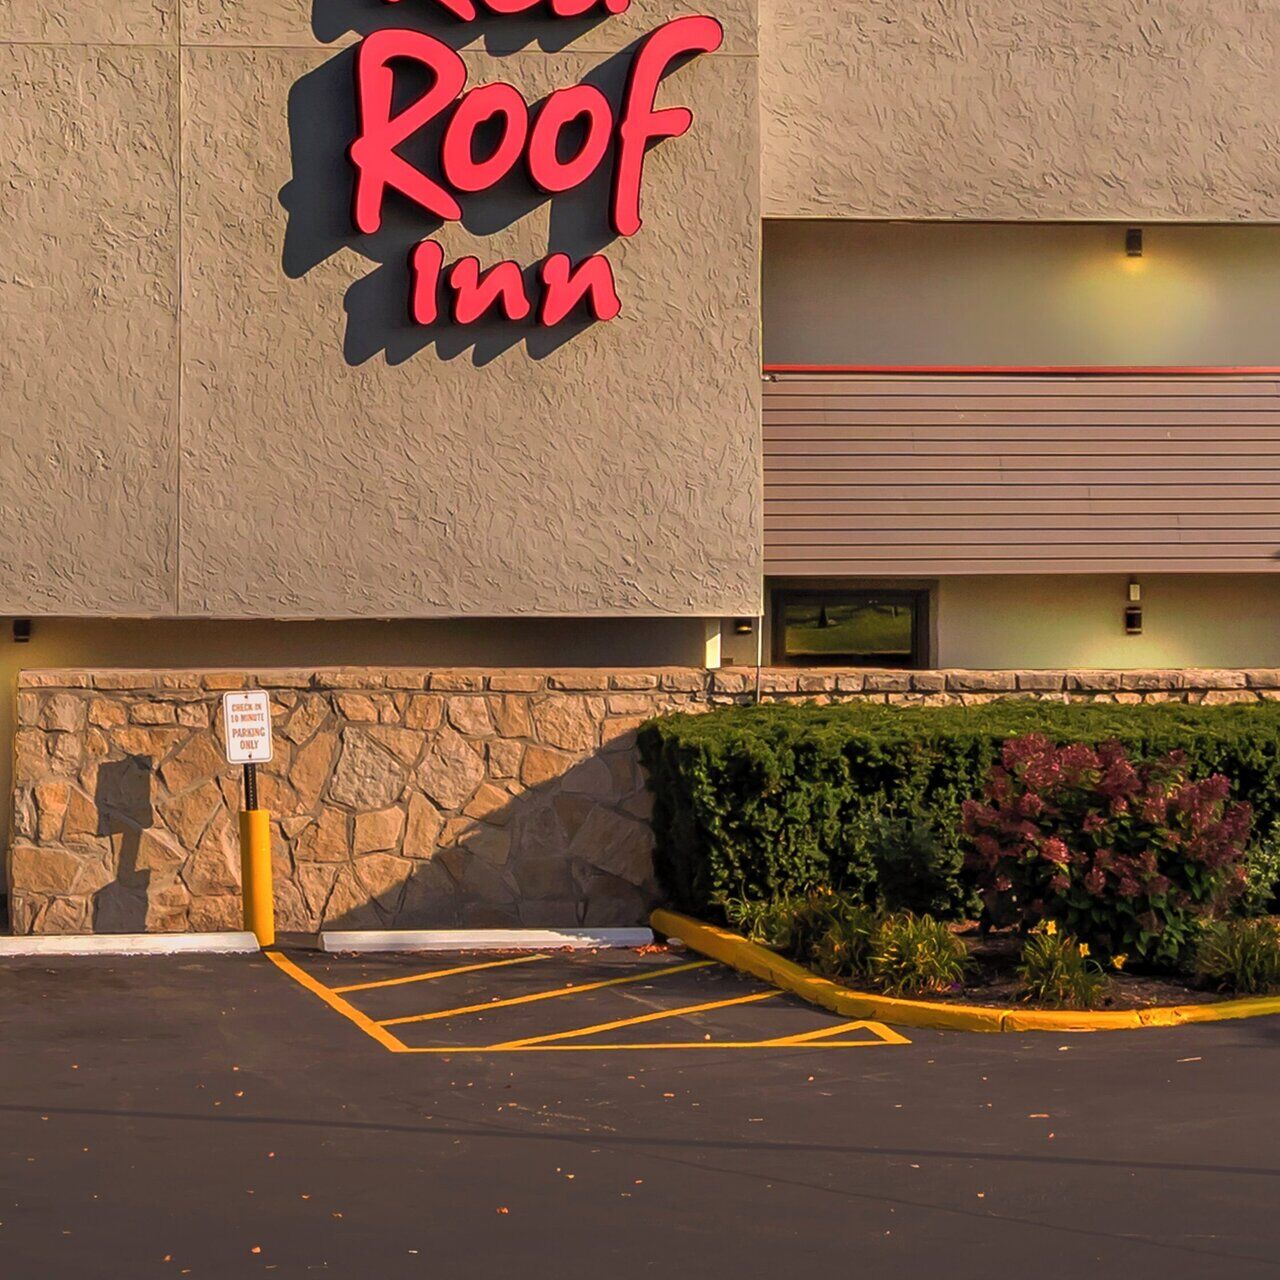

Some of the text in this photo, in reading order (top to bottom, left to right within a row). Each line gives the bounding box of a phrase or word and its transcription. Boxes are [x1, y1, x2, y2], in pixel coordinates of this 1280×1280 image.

[350, 14, 724, 238] Roof
[231, 703, 253, 712] CHECK
[240, 713, 264, 722] MINUTE
[232, 727, 265, 738] PARKING
[240, 740, 259, 750] ONLY
